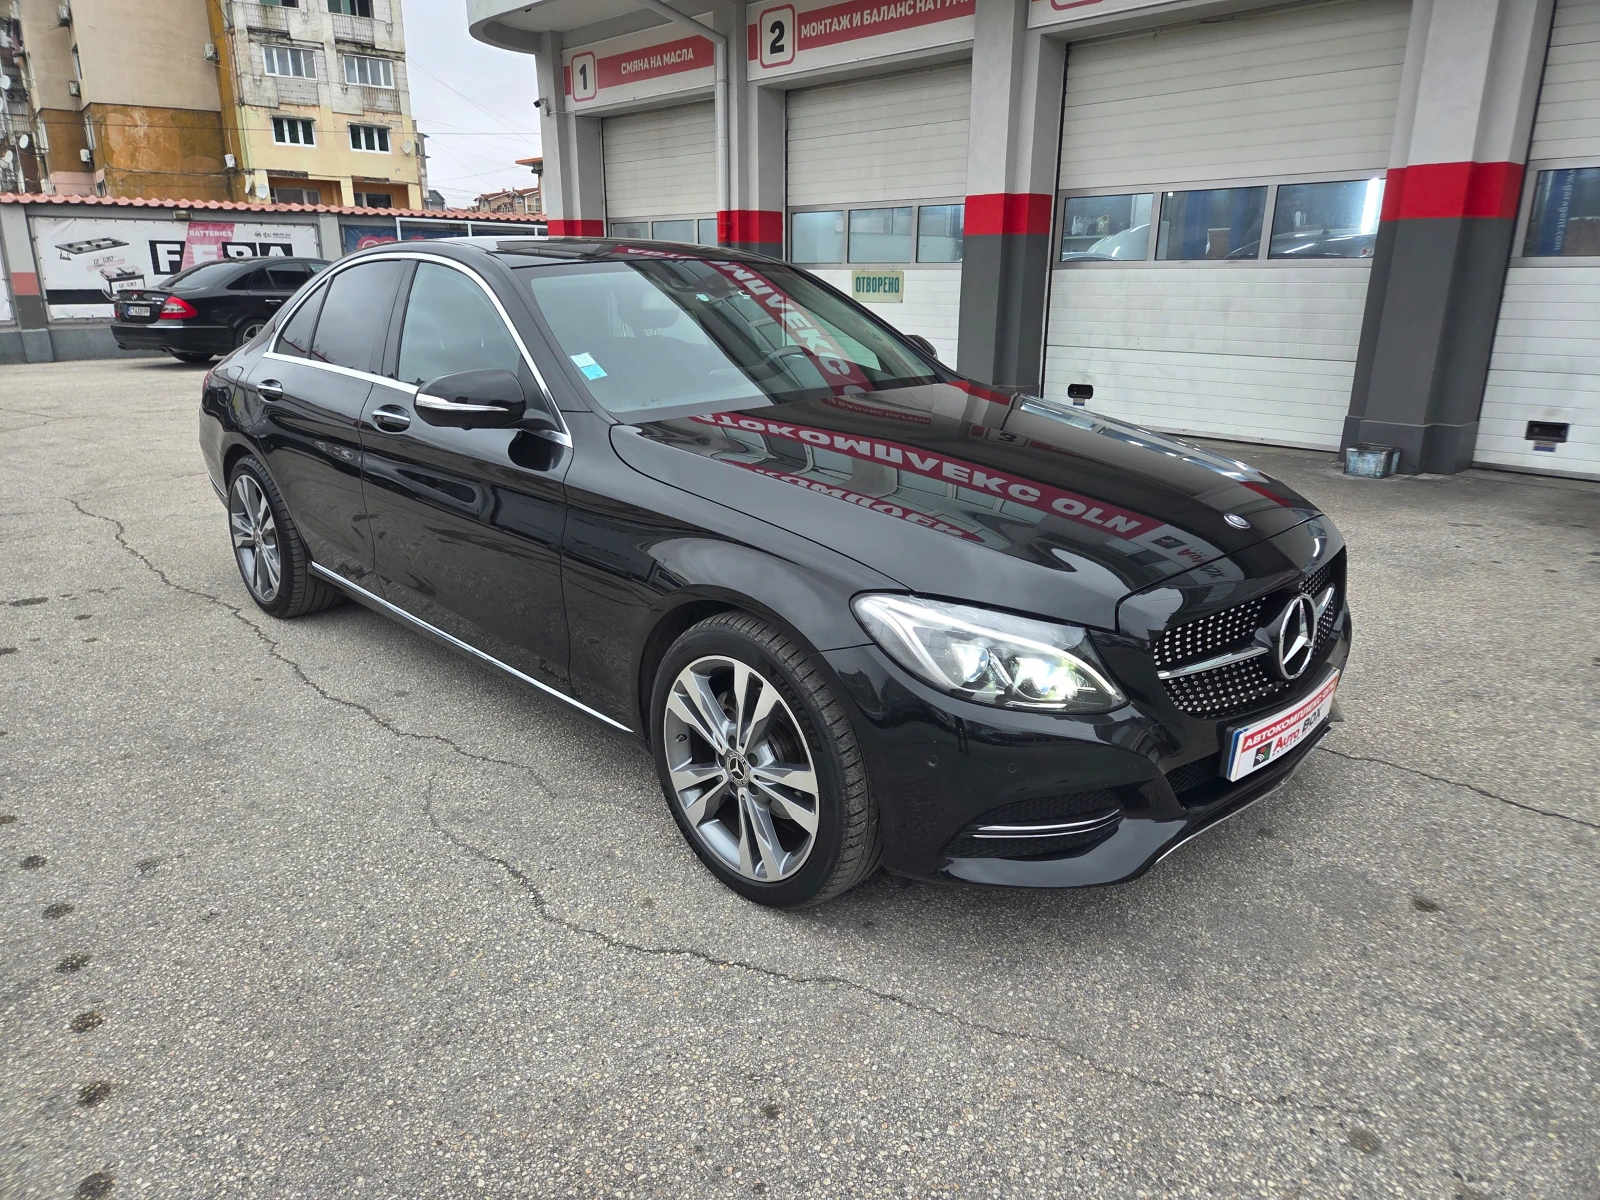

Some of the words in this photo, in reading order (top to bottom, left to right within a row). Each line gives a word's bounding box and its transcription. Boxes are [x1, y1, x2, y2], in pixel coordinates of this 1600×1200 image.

[801, 13, 850, 39] МОНТАЖ
[852, 11, 860, 28] И
[863, 0, 914, 26] БАЛАНС
[916, 0, 935, 14] НА
[769, 20, 785, 55] 2
[579, 63, 587, 90] 1
[621, 57, 650, 75] СМЯНА
[650, 55, 662, 69] НА
[663, 47, 694, 66] МАСЛА
[189, 229, 233, 238] BATTERIES
[856, 276, 900, 293] ОТВОРЕНО
[773, 673, 823, 752] MICHELIN
[1244, 695, 1322, 748] АВТОКОМПЛЕКС
